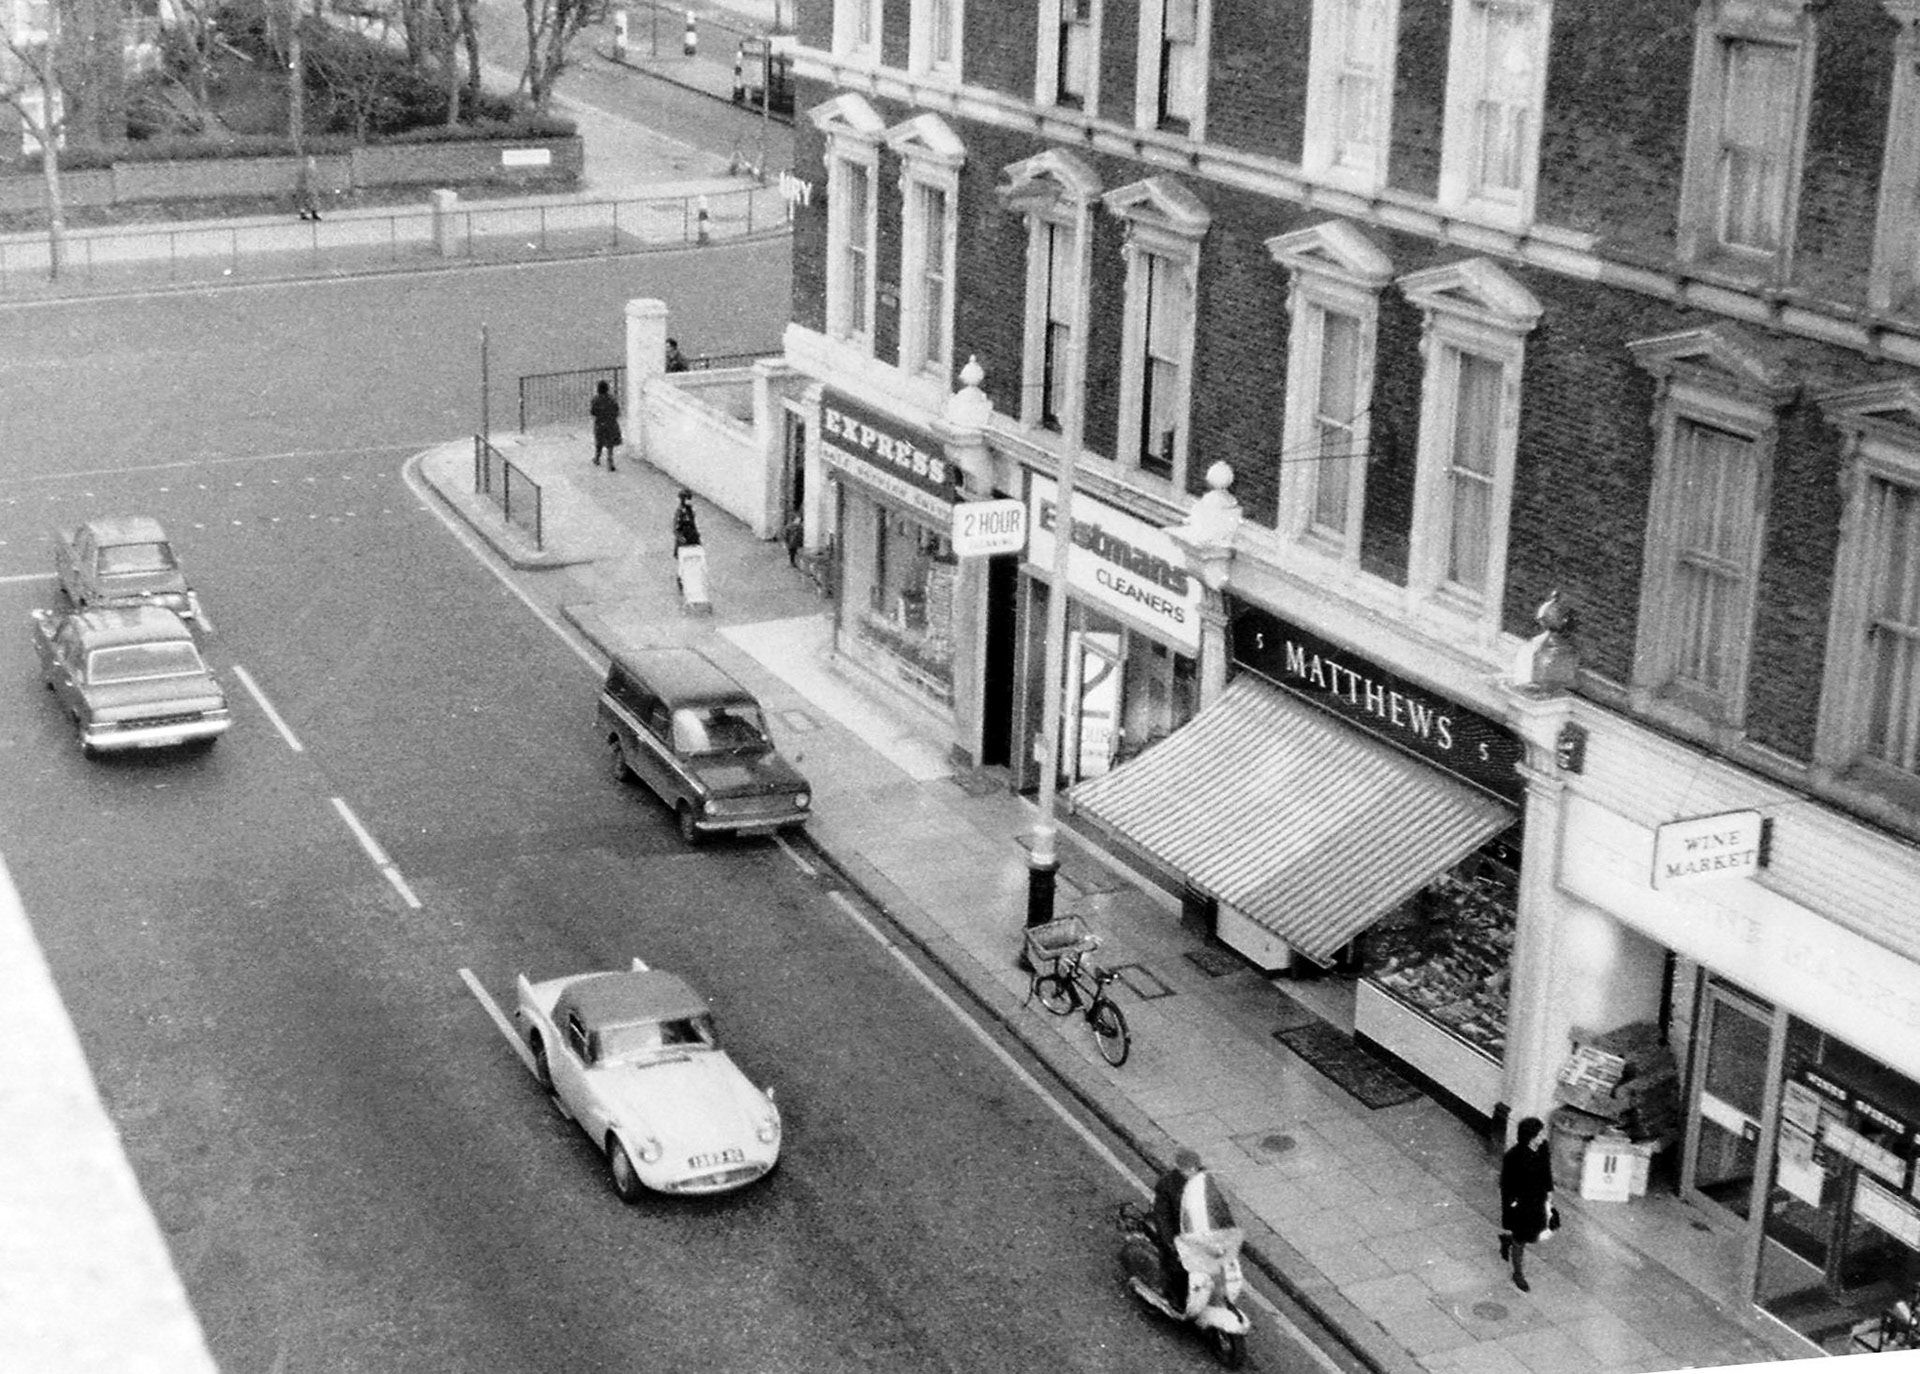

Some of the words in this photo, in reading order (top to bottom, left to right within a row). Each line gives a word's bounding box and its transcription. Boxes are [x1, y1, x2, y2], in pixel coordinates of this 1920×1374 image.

[825, 408, 946, 484] EXPRESS
[964, 513, 976, 537] 2
[979, 509, 1021, 535] HOUR
[1096, 569, 1185, 624] CLEANERS
[1286, 640, 1452, 749] MATTHEWS
[1684, 830, 1740, 850] WINE
[1666, 849, 1756, 878] MARKET
